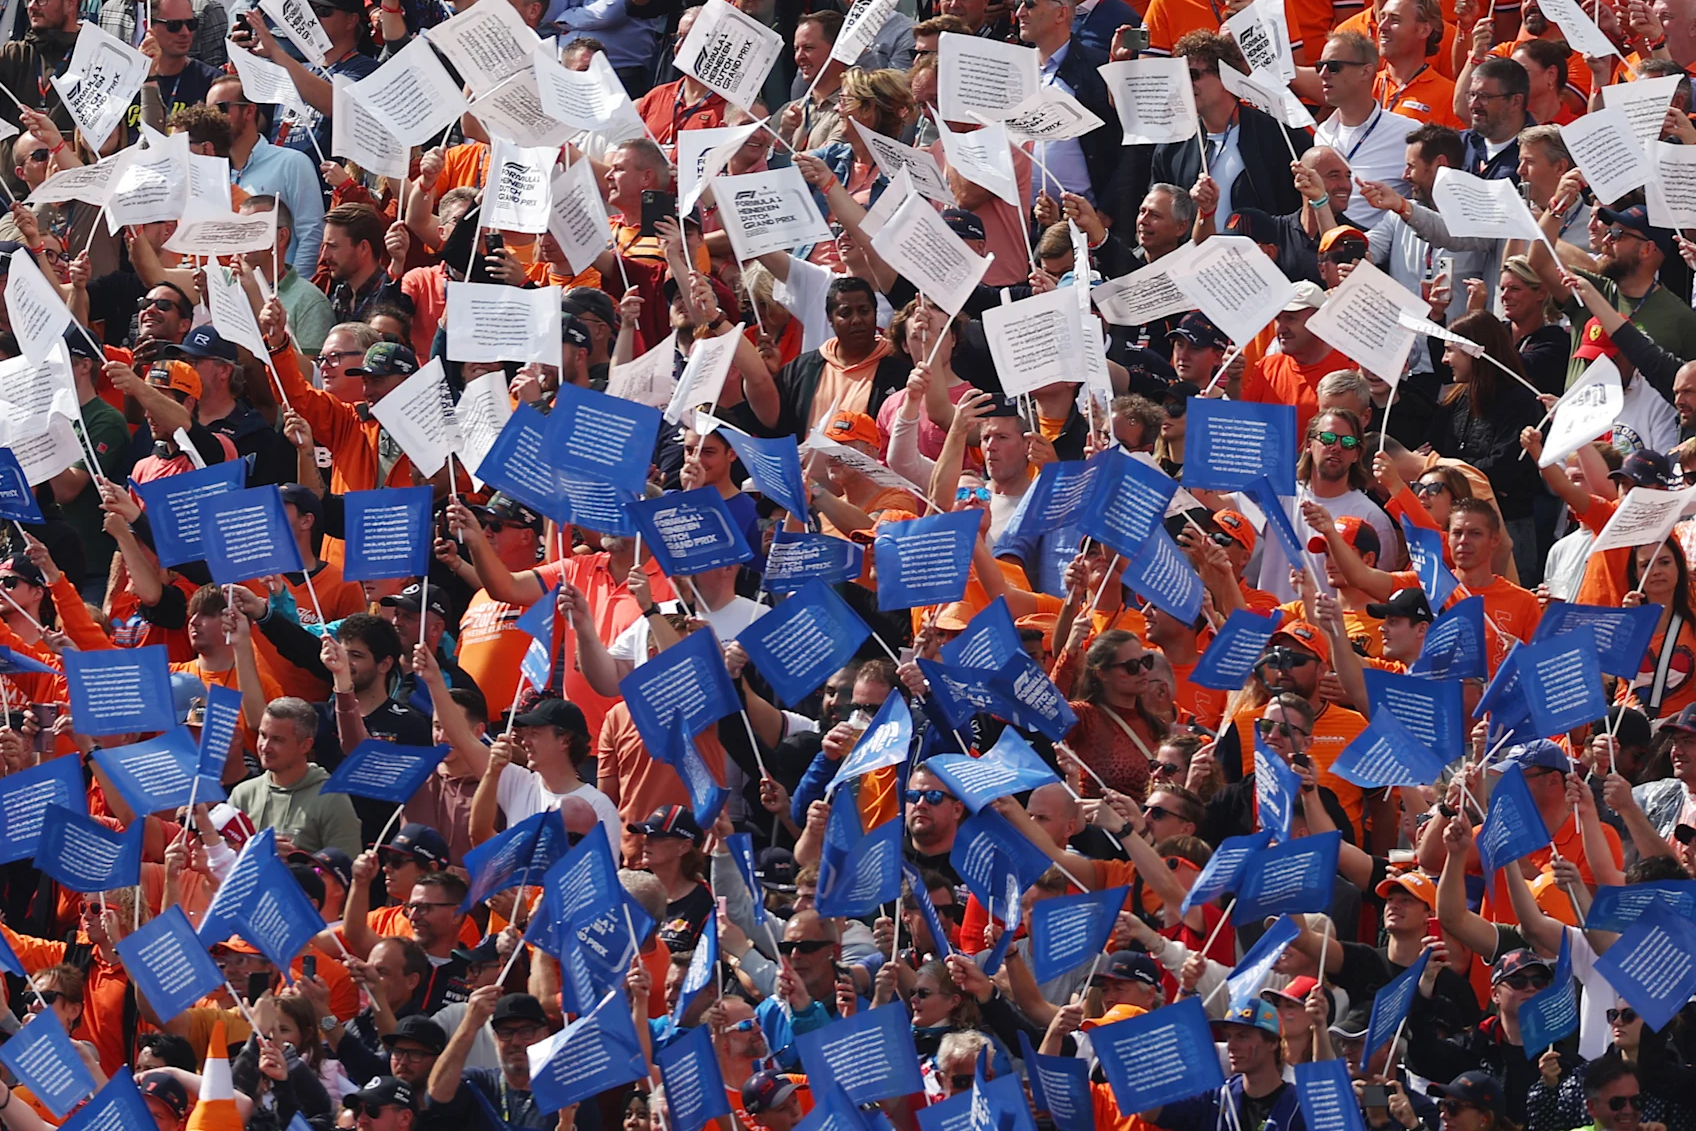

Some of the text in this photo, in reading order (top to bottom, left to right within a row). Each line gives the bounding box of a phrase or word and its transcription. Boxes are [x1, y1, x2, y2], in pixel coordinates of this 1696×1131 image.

[699, 38, 727, 80] FORMULA
[706, 41, 733, 85] HEINEKEN
[722, 39, 754, 90] GRAND PRIX
[713, 57, 733, 88] DUTCH
[734, 198, 775, 208] FORMULA
[737, 204, 780, 215] HEINEKEN
[739, 213, 770, 223] DUTCH
[743, 214, 797, 230] GRAND PRIX
[693, 533, 718, 546] PRIX
